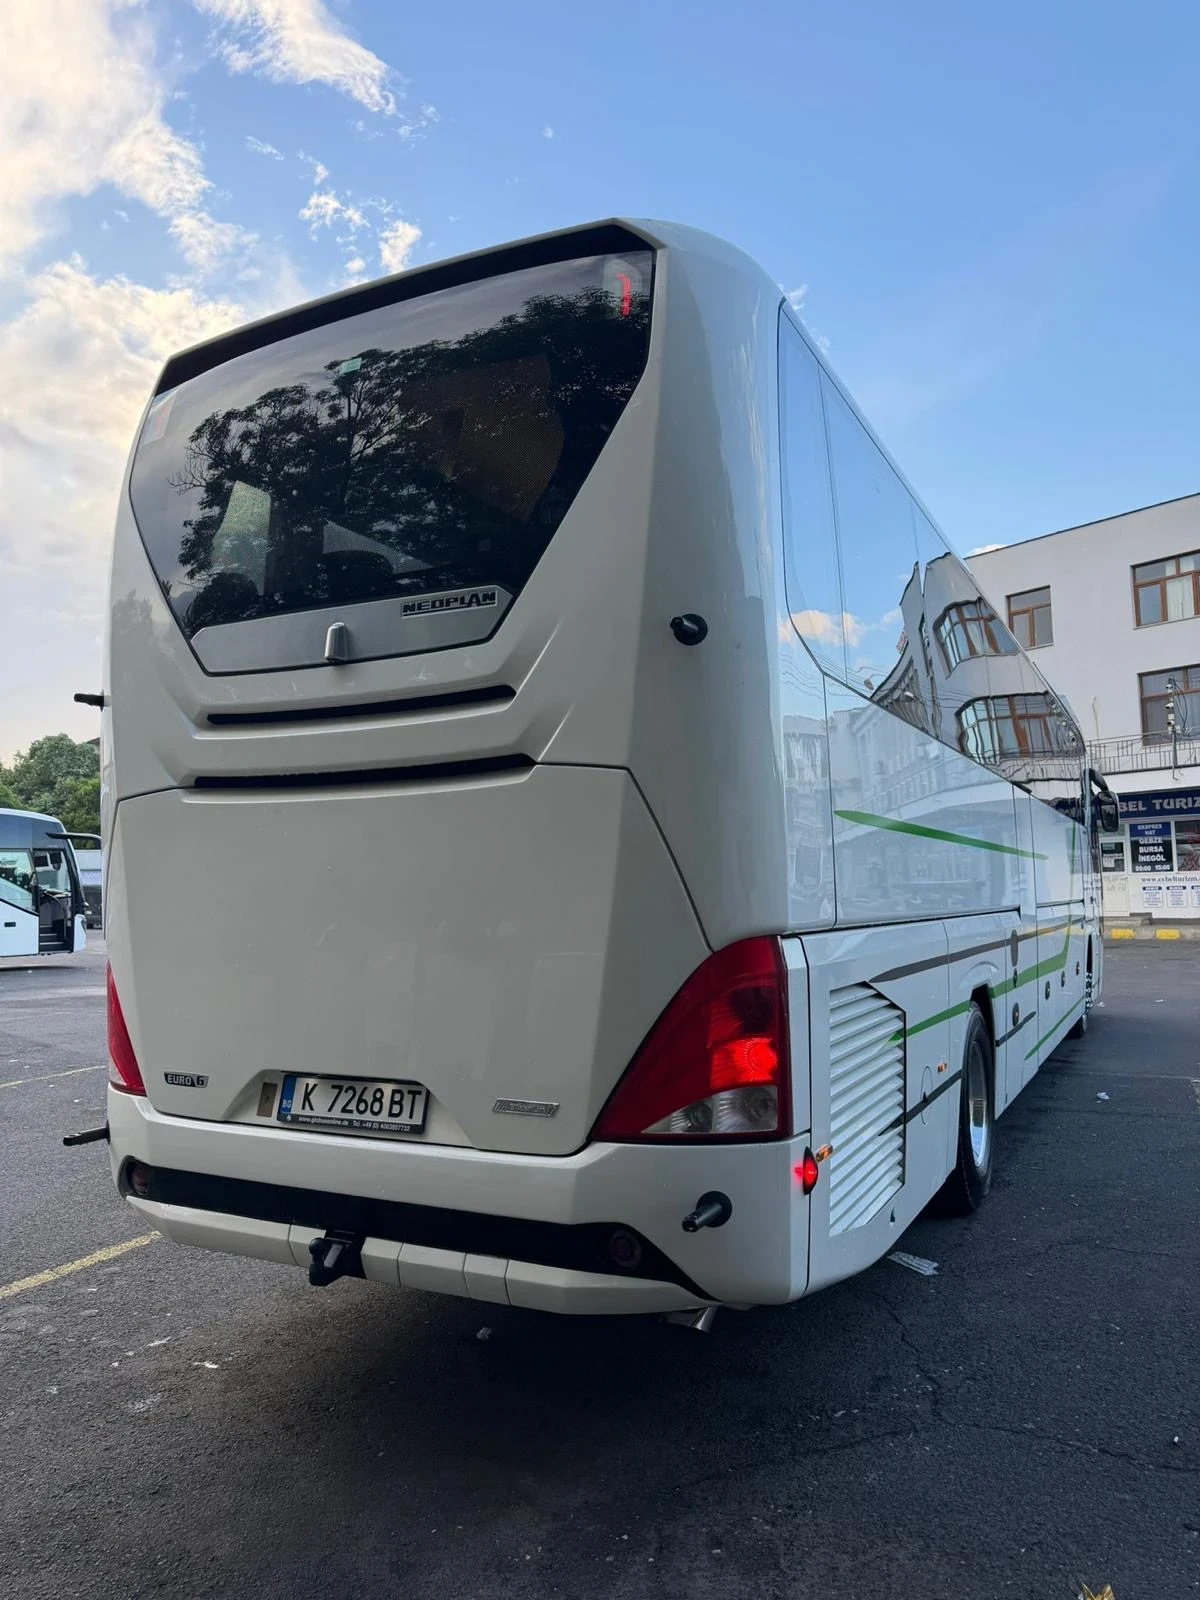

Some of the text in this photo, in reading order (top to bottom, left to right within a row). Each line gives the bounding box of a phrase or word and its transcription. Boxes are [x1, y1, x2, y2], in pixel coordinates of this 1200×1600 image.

[402, 591, 496, 613] NEOPLAN
[1139, 836, 1163, 844] GEBZE
[1138, 845, 1164, 853] BURSA
[1138, 853, 1166, 862] İNEGÖL
[167, 1074, 192, 1085] EURO
[282, 1099, 292, 1108] BG
[301, 1082, 422, 1120] K 7268 BT
